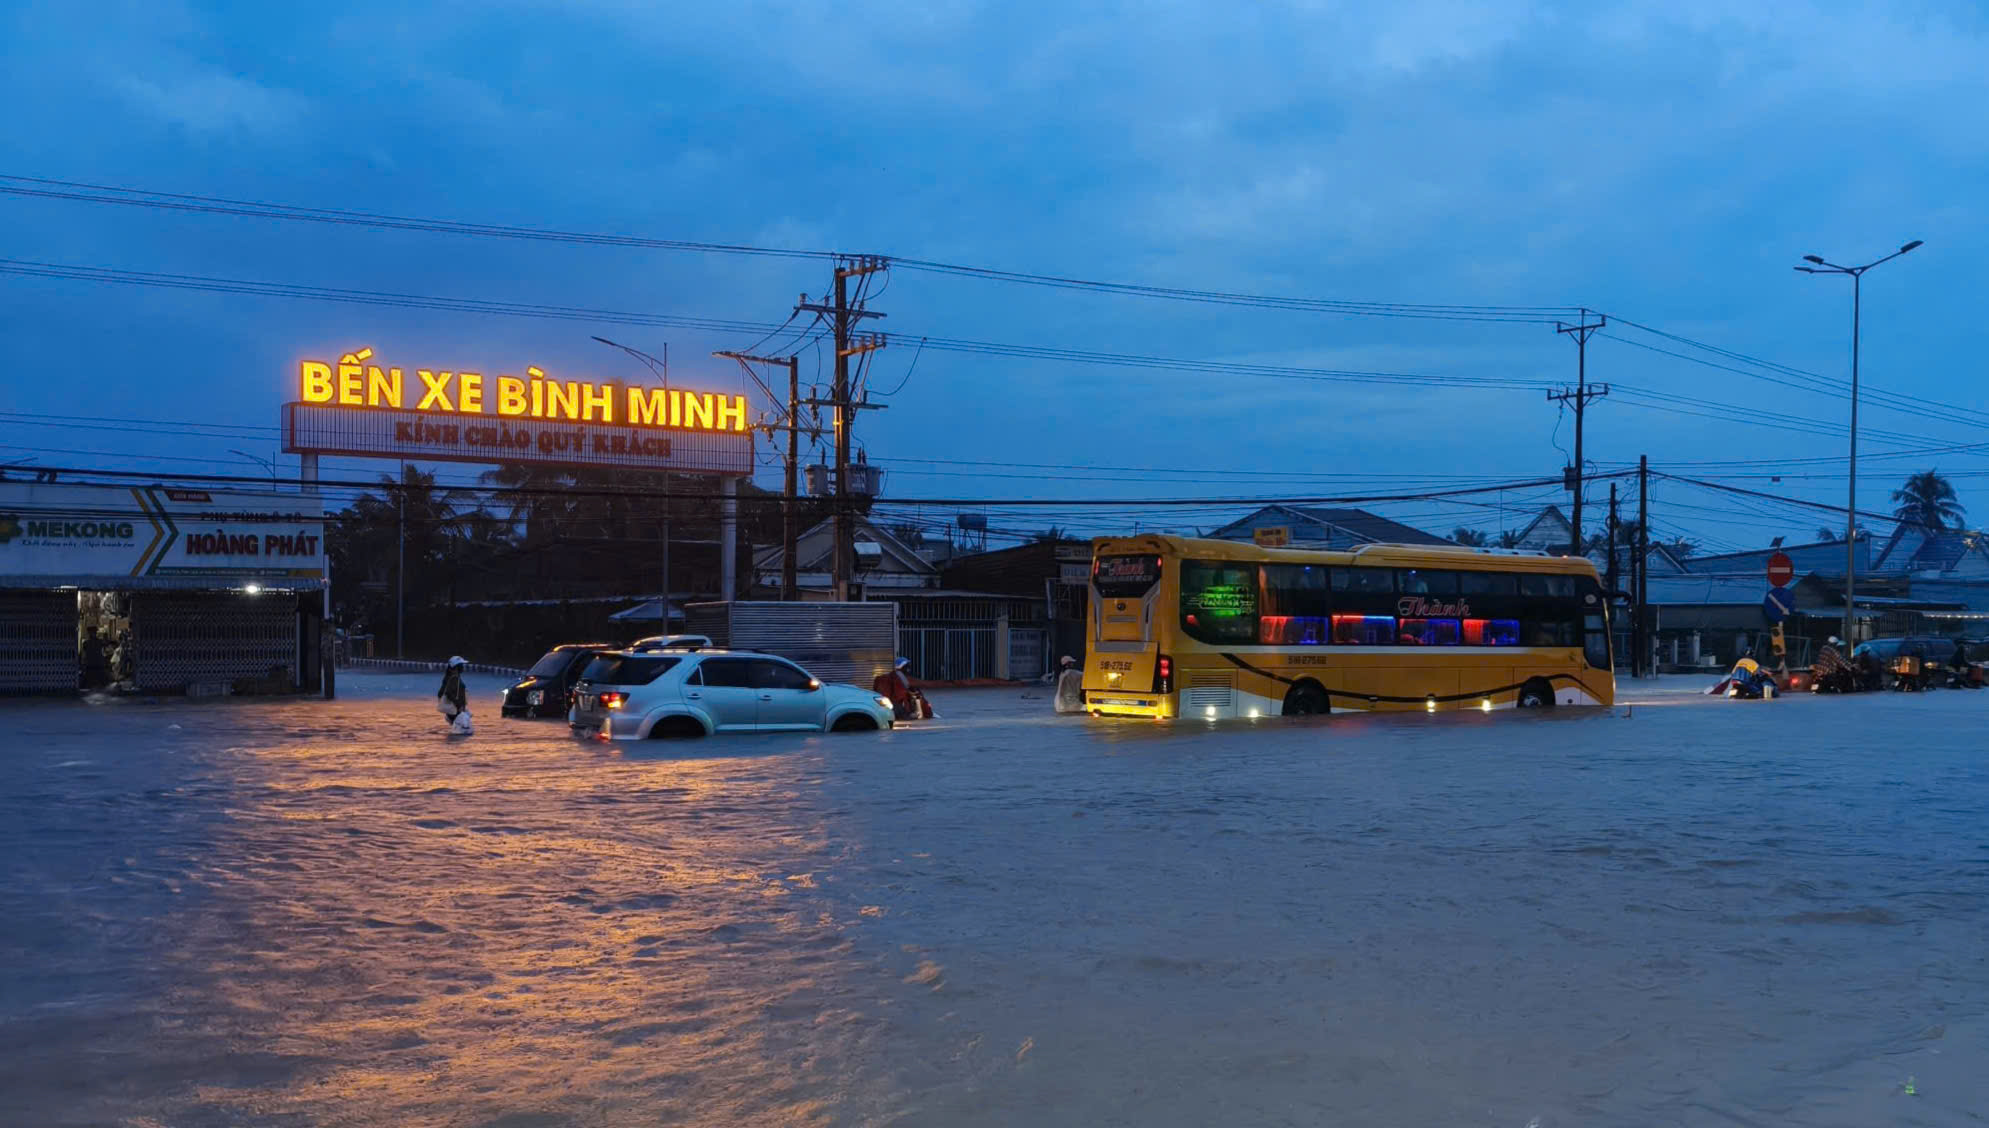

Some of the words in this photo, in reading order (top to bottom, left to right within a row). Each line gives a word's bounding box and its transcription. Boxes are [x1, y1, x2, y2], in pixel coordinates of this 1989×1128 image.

[302, 347, 401, 408] BẾN
[416, 368, 482, 414] XE
[496, 366, 614, 422] BÌNH
[627, 386, 747, 432] MINH
[396, 416, 459, 445] KÍNH
[464, 420, 531, 449] CHÀO
[537, 427, 586, 454] QUÝ
[594, 430, 672, 457] KHÁCH
[27, 521, 134, 538] MEKONG
[186, 528, 259, 555] HOÀNG
[265, 530, 319, 556] PHÁT
[1397, 596, 1471, 617] Thành
